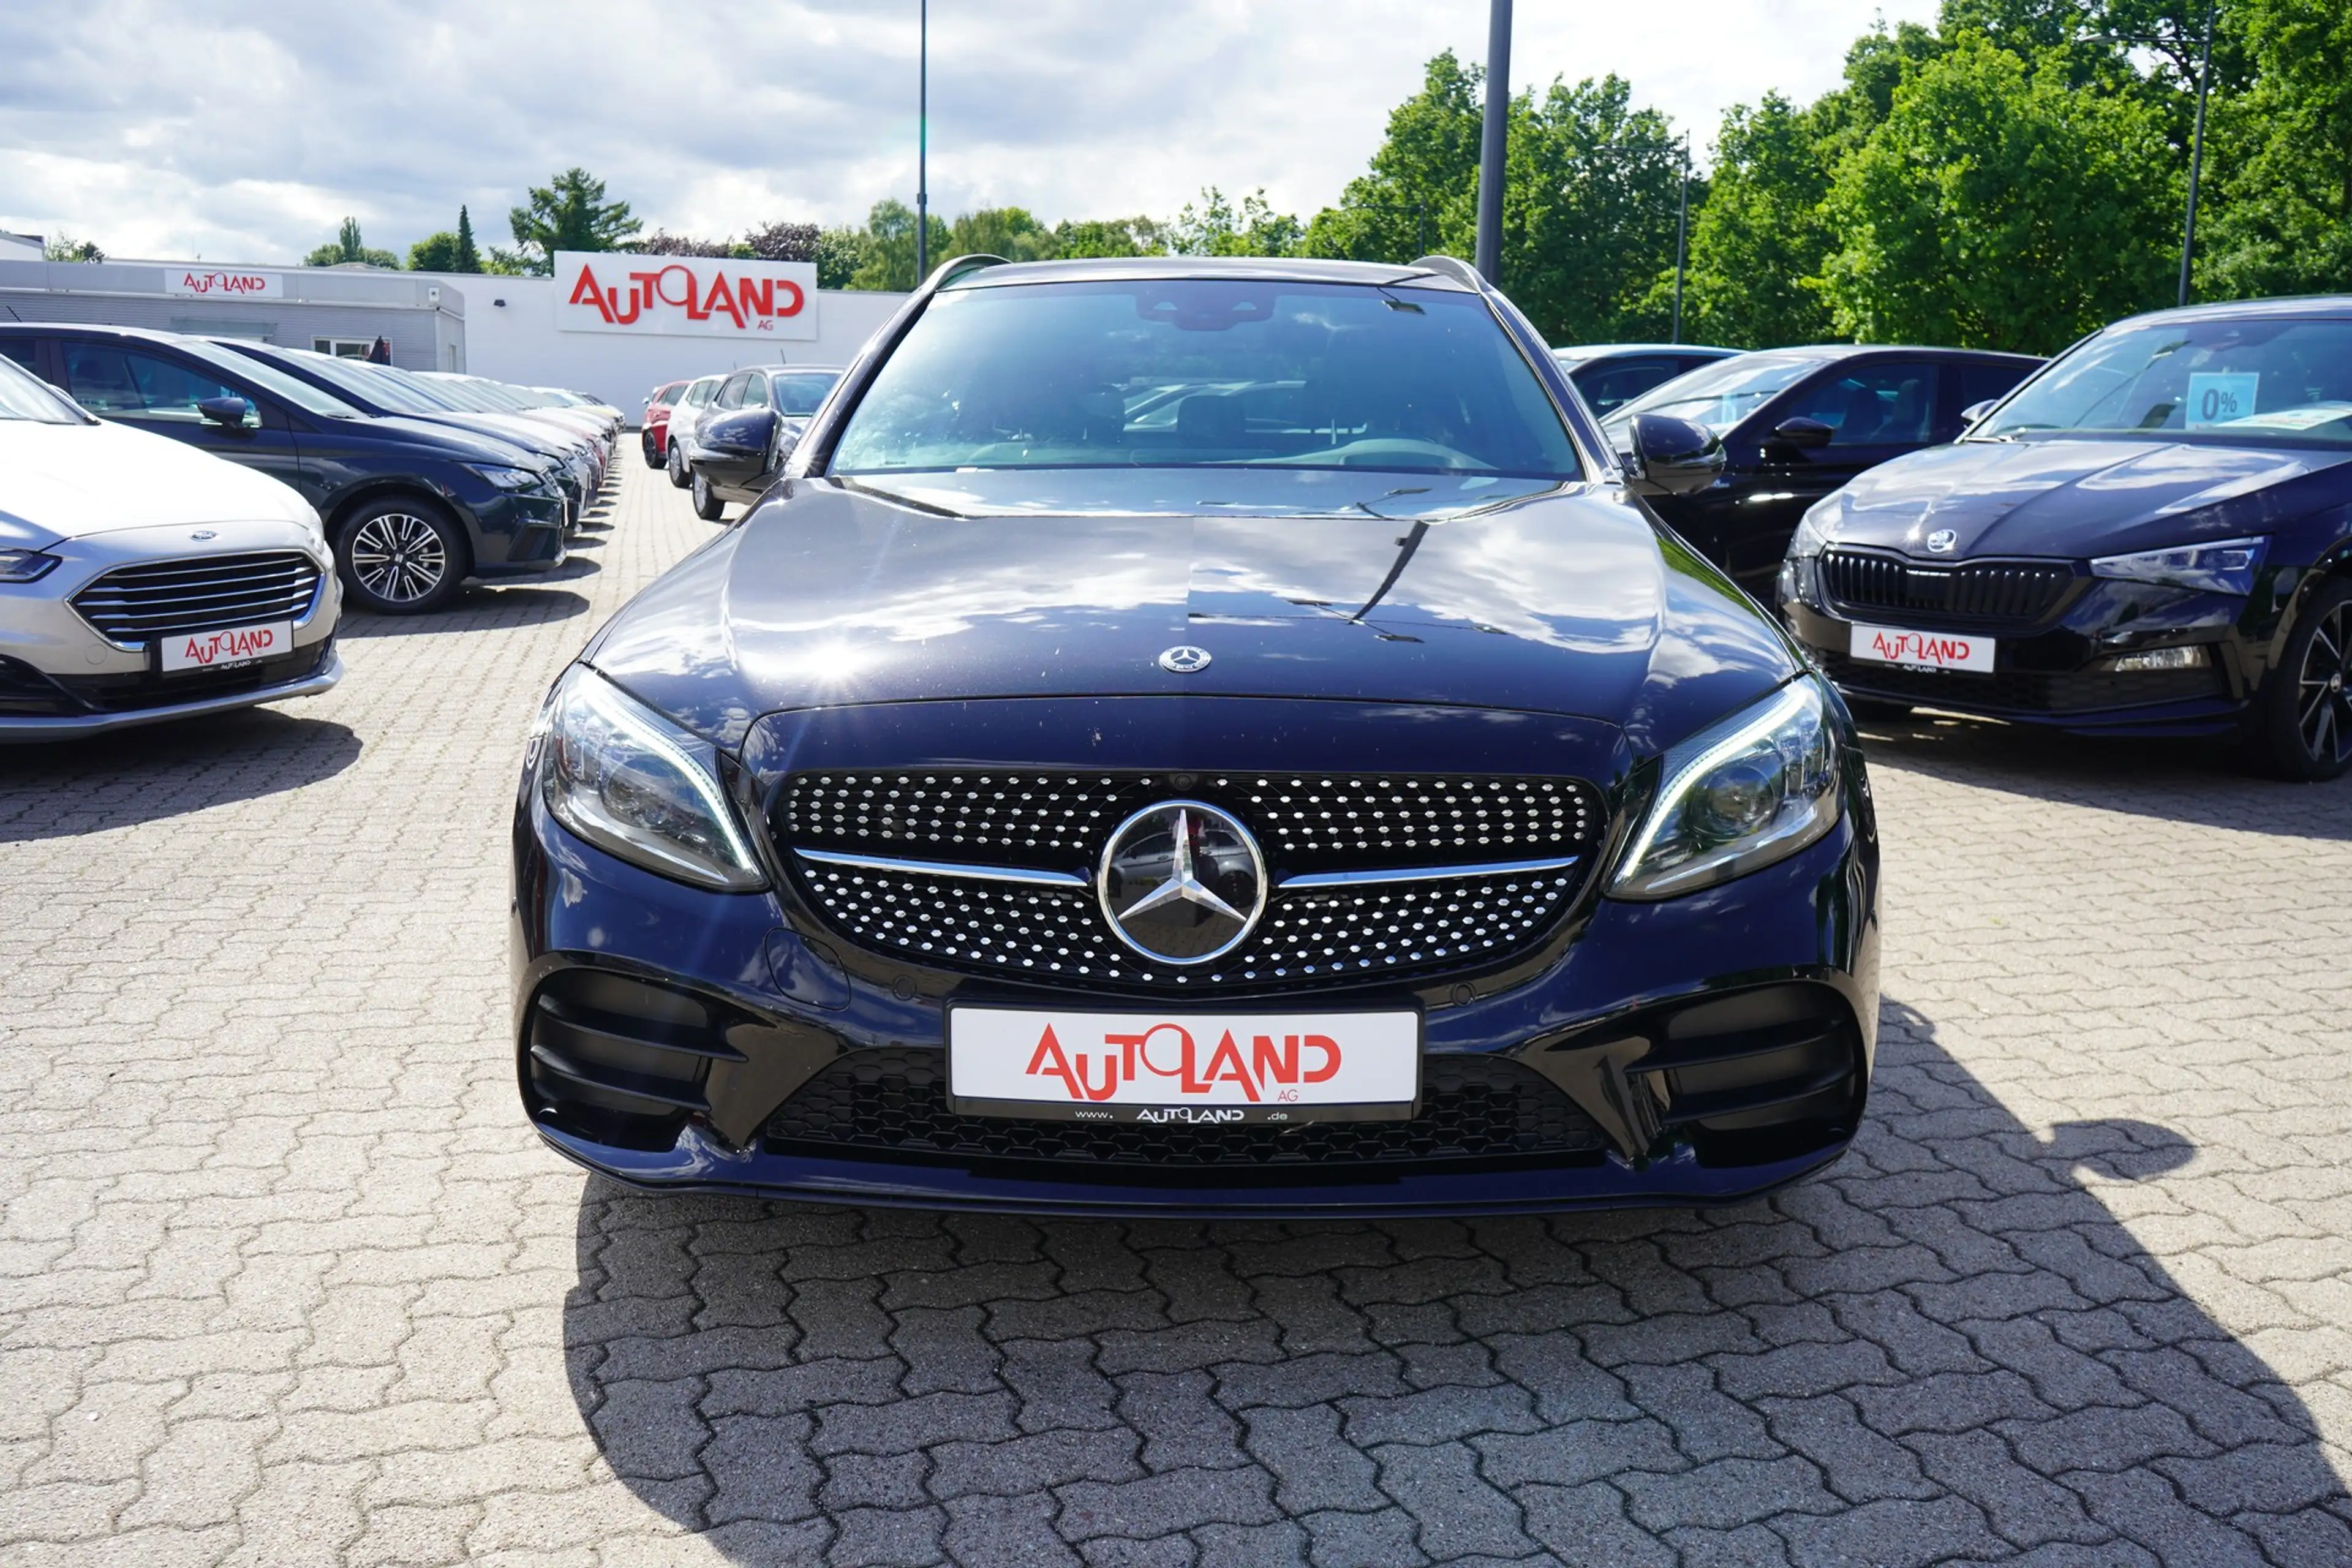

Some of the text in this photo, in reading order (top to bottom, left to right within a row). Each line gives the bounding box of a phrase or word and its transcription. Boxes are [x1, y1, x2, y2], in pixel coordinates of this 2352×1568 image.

[184, 272, 265, 294] AUTOLAND
[569, 263, 804, 329] AUTOLAND
[757, 319, 774, 331] AG
[185, 629, 273, 664] AUTOLAND
[1872, 631, 1970, 665] AUTOLAND
[1026, 1023, 1341, 1102] AUTOLAND
[1278, 1090, 1298, 1102] AG
[1075, 1110, 1114, 1119] www.
[1136, 1107, 1245, 1123] AUTOLAND
